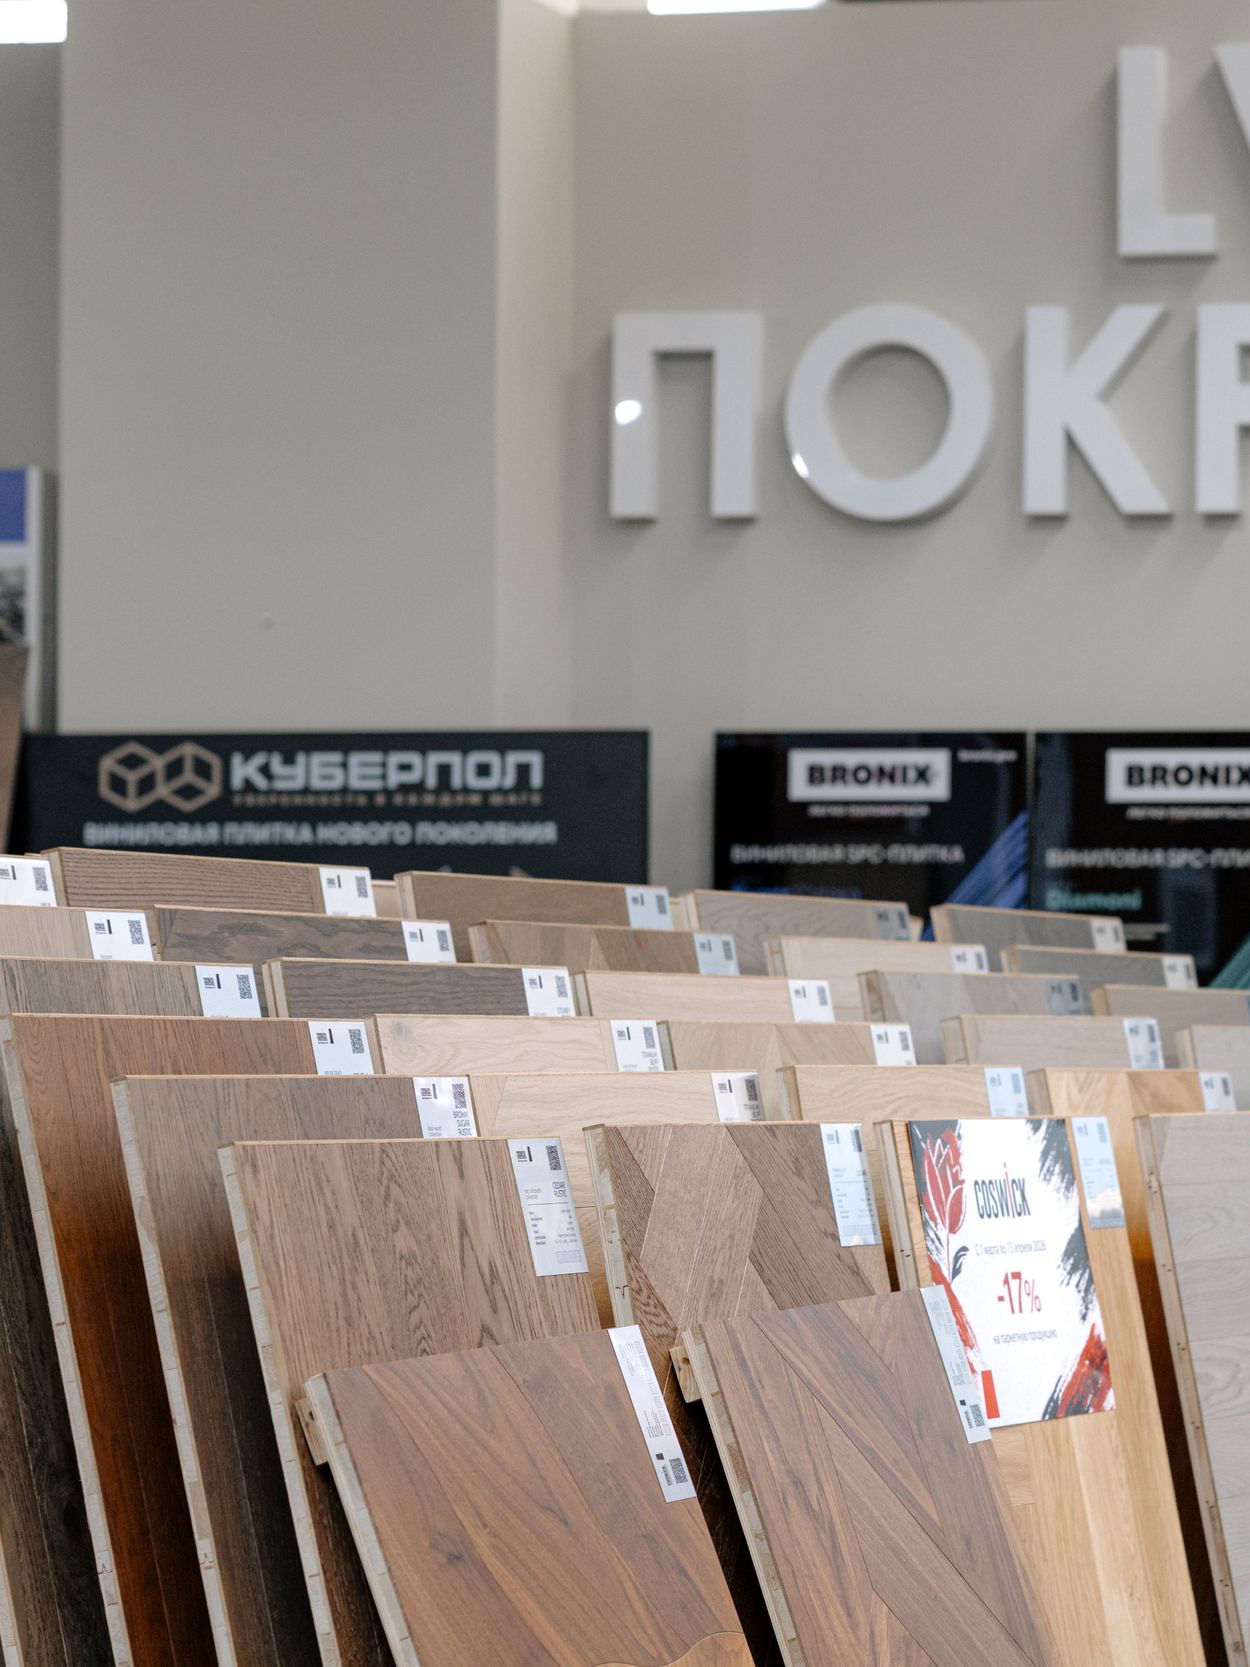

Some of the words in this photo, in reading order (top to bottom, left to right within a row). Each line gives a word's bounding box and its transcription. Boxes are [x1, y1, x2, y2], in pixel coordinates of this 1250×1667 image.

[231, 750, 544, 791] КУБЕРПОЛ
[808, 764, 932, 786] BRONIX
[83, 821, 220, 846] ВИНИЛОВАЯ
[222, 821, 314, 846] ПЛИТКА
[315, 820, 414, 846] НОВОГО
[414, 820, 559, 845] ПОКОЛЕНИЯ
[729, 844, 842, 865] ВИНИЛОВАЯ
[1045, 847, 1163, 868] ВИНИЛОВАЯ
[997, 1271, 1042, 1315] -17%
